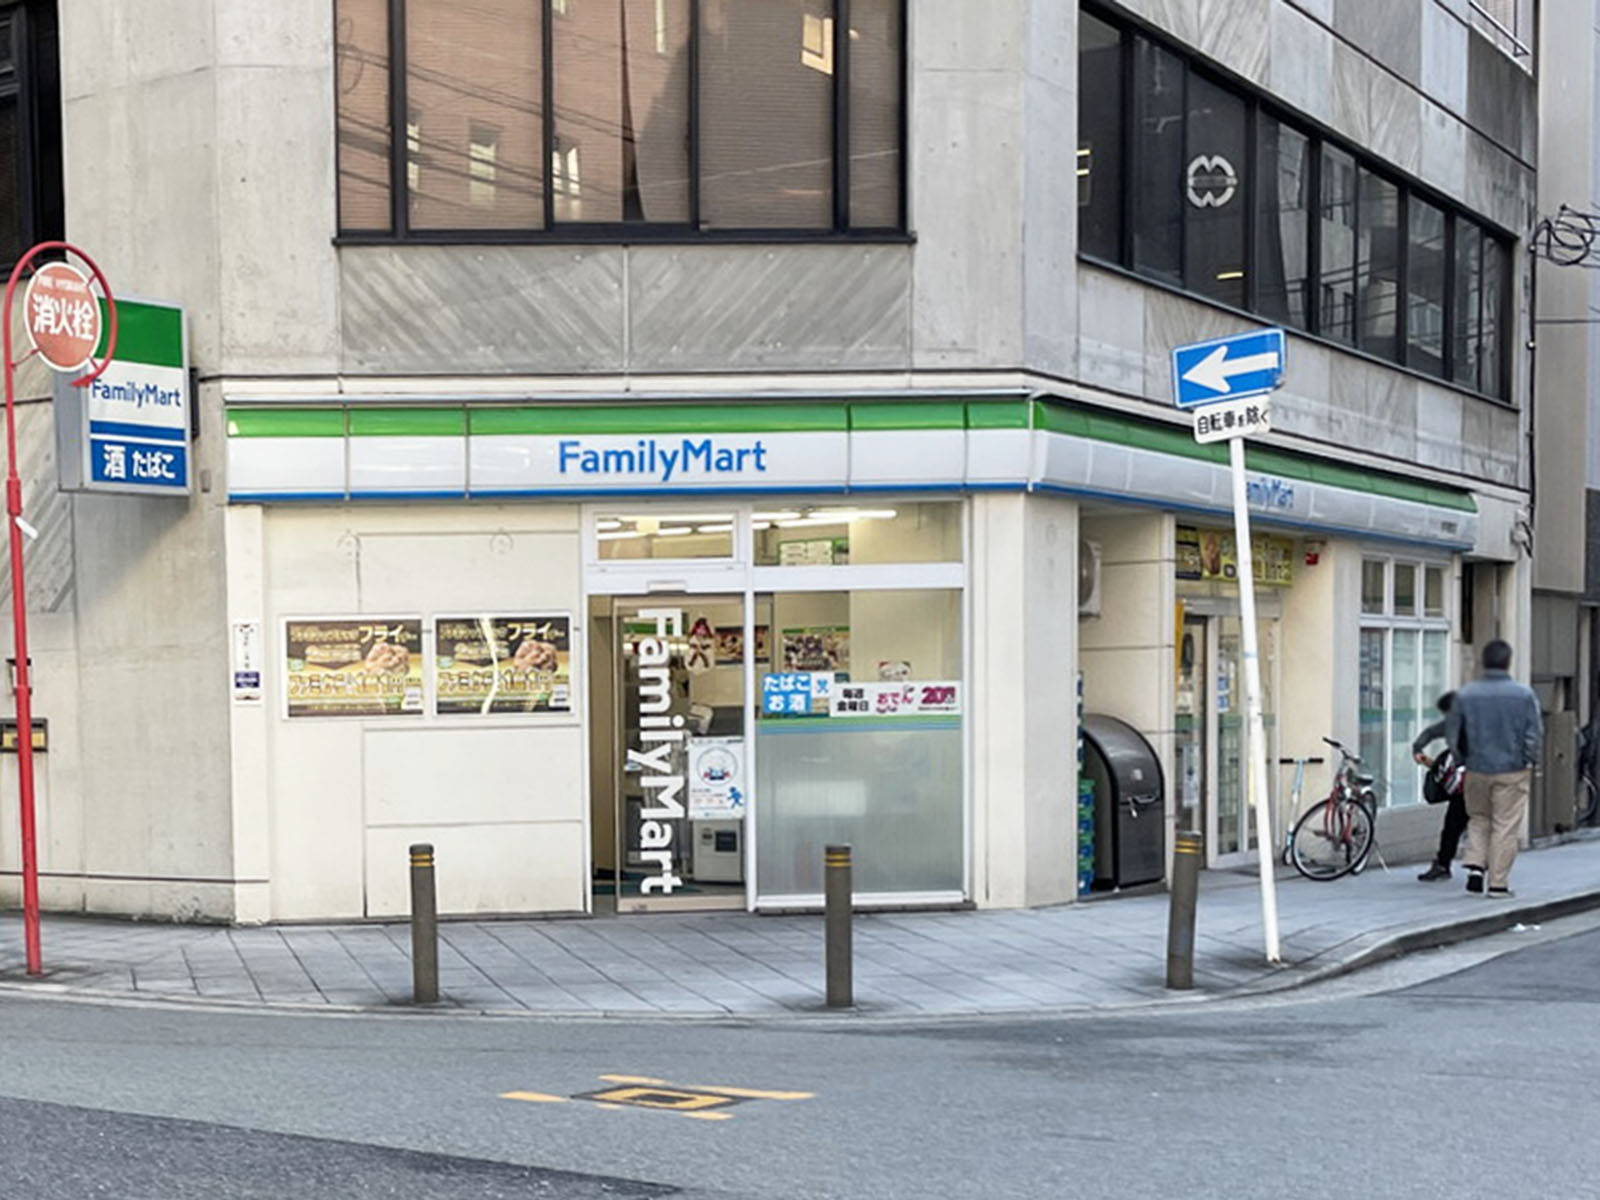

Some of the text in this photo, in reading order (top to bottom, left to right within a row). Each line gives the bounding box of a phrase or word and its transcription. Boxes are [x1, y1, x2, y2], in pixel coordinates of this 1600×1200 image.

[33, 293, 94, 340] 消火栓
[92, 378, 181, 409] FamilyMart
[1198, 405, 1268, 434] 自転車を除く
[103, 444, 175, 478] 酒 たばこ
[559, 439, 766, 482] FamilyMart
[359, 625, 403, 643] フライ
[507, 622, 551, 641] フライ
[764, 675, 811, 692] たばこ
[768, 694, 807, 712] お酒
[837, 701, 869, 712] 金曜日
[627, 608, 685, 894] FamilyMart
